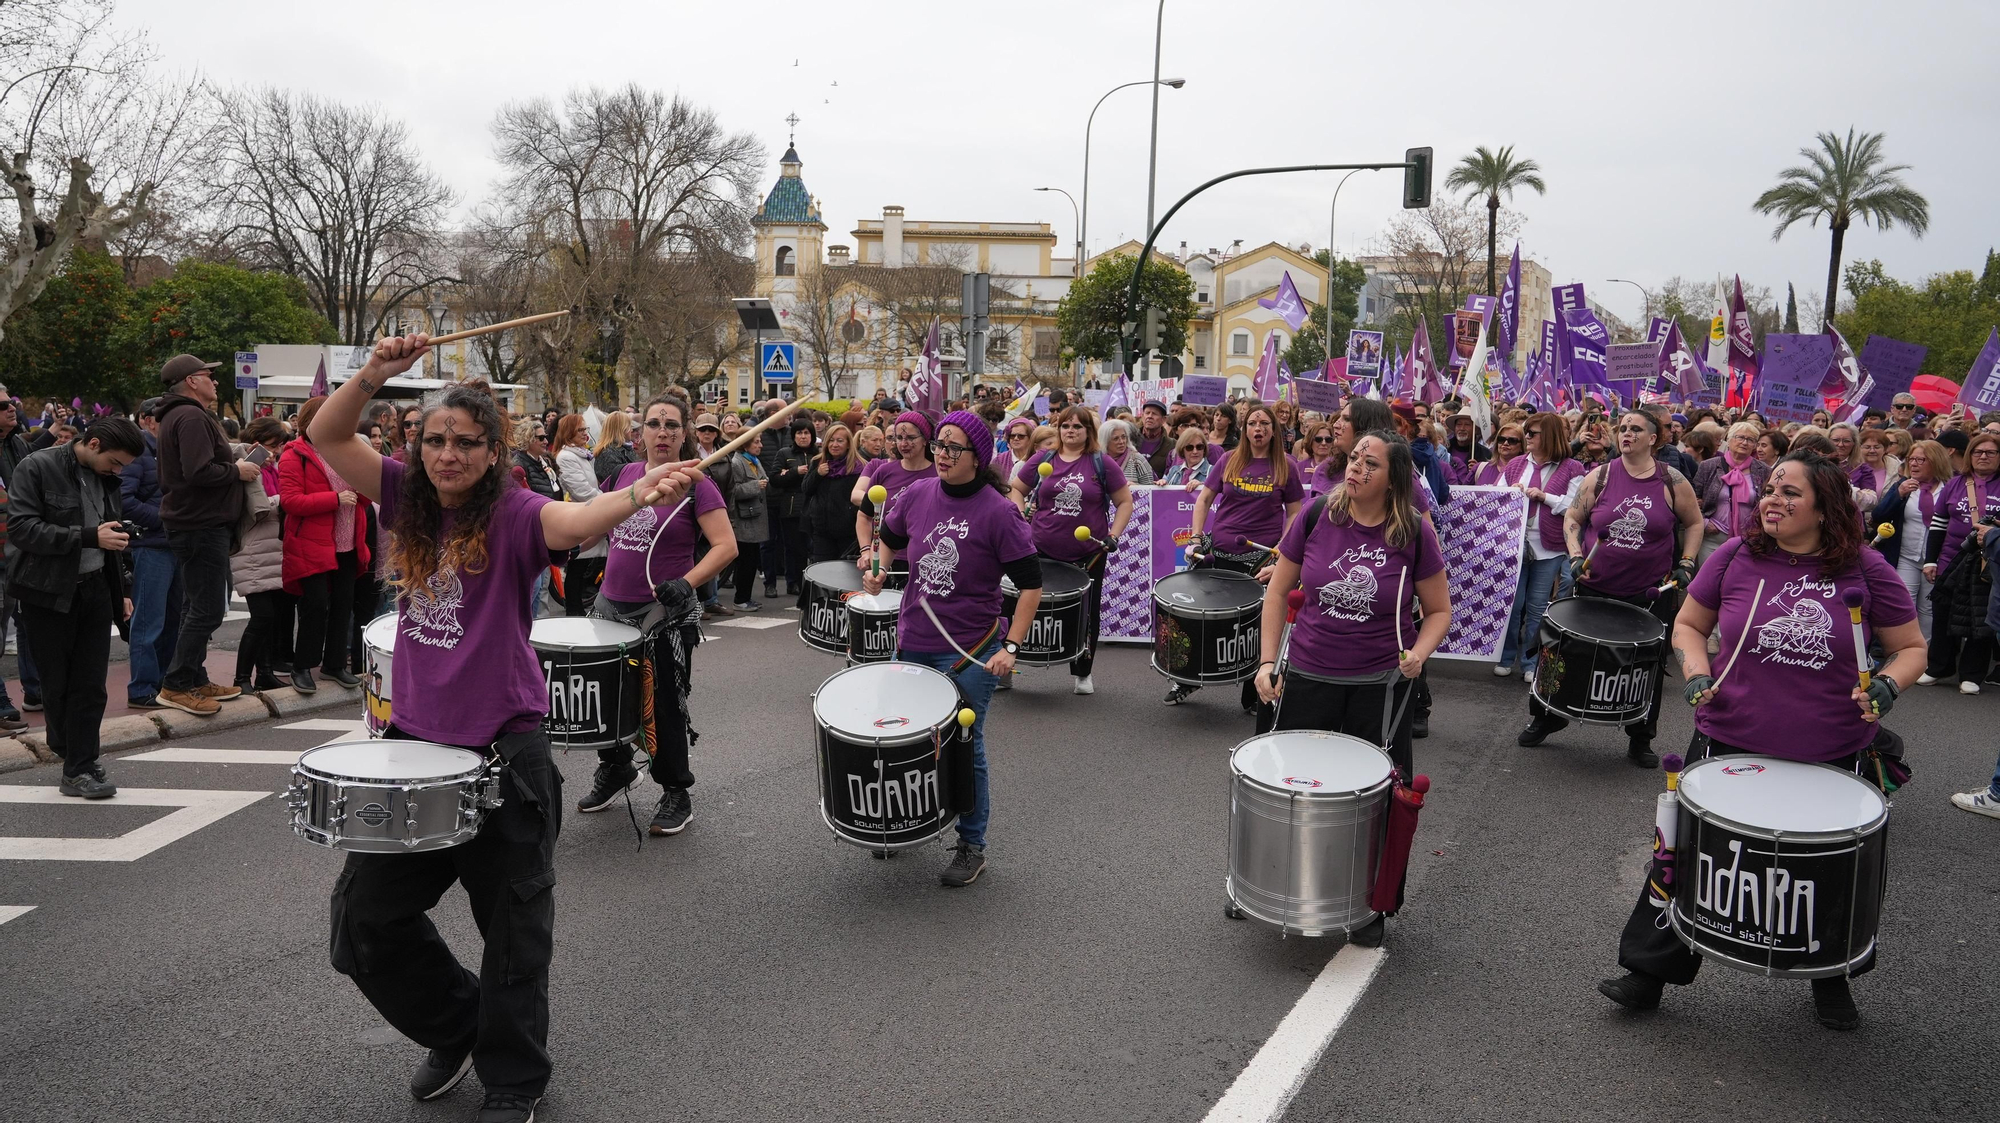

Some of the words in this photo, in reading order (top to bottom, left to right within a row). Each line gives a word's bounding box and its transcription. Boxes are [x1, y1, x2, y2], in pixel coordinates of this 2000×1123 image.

[1772, 383, 1788, 392] PUTA
[1138, 489, 1149, 497] 8M
[1451, 491, 1465, 500] 8M
[1463, 492, 1477, 503] 8M
[1510, 491, 1524, 500] 8M
[1475, 495, 1488, 508] 8M
[1486, 500, 1500, 511] 8M
[1138, 505, 1150, 515] 8M
[1440, 503, 1453, 514] 8M
[1451, 507, 1465, 518] 8M
[1497, 504, 1511, 515] 8M
[1463, 511, 1476, 523] 8M
[1509, 509, 1523, 520] 8M
[1475, 515, 1488, 526] 8M
[1485, 520, 1499, 531] 8M
[1138, 523, 1150, 533] 8M
[1451, 526, 1464, 538] 8M
[1496, 523, 1509, 535] 8M
[1506, 528, 1520, 539] 8M
[1462, 531, 1476, 542] 8M
[1473, 535, 1487, 546] 8M
[1139, 539, 1150, 550] 8M
[1441, 542, 1453, 553] 8M
[1484, 539, 1496, 550] 8M
[1494, 543, 1507, 554] 8M
[1450, 546, 1464, 558] 8M
[1462, 550, 1476, 561] 8M
[1505, 547, 1519, 558] 8M
[1138, 556, 1150, 566] 8M
[1473, 554, 1485, 566] 8M
[1483, 558, 1496, 569] 8M
[1450, 565, 1464, 577] 8M
[1494, 561, 1506, 572] 8M
[1504, 565, 1518, 577] 8M
[1128, 569, 1140, 580] 8M
[1461, 570, 1475, 580] 8M
[1472, 573, 1485, 584] 8M
[1482, 576, 1496, 588] 8M
[1493, 580, 1506, 592] 8M
[1119, 584, 1130, 593] 8M
[1450, 584, 1464, 595] 8M
[1461, 588, 1475, 599] 8M
[1504, 584, 1516, 596] 8M
[1101, 593, 1111, 604] 8M
[1472, 591, 1485, 603] 8M
[1482, 595, 1495, 607] 8M
[1128, 603, 1140, 613] 8M
[1451, 603, 1462, 613] 8M
[1493, 599, 1506, 611] 8M
[1461, 607, 1474, 617] 8M
[1471, 610, 1484, 622] 8M
[1110, 613, 1120, 623] 8M
[1482, 614, 1495, 625] 8M
[1139, 623, 1150, 633] 8M
[1450, 621, 1463, 632] 8M
[1493, 619, 1505, 630] 8M
[1460, 625, 1473, 636] 8M
[1471, 629, 1483, 640] 8M
[1481, 633, 1494, 644] 8M
[1448, 640, 1461, 651] 8M
[1459, 644, 1472, 654] 8M
[1470, 648, 1482, 656] 8M
[891, 818, 921, 830] sister
[1696, 912, 1733, 934] sound
[1739, 929, 1781, 946] sister
